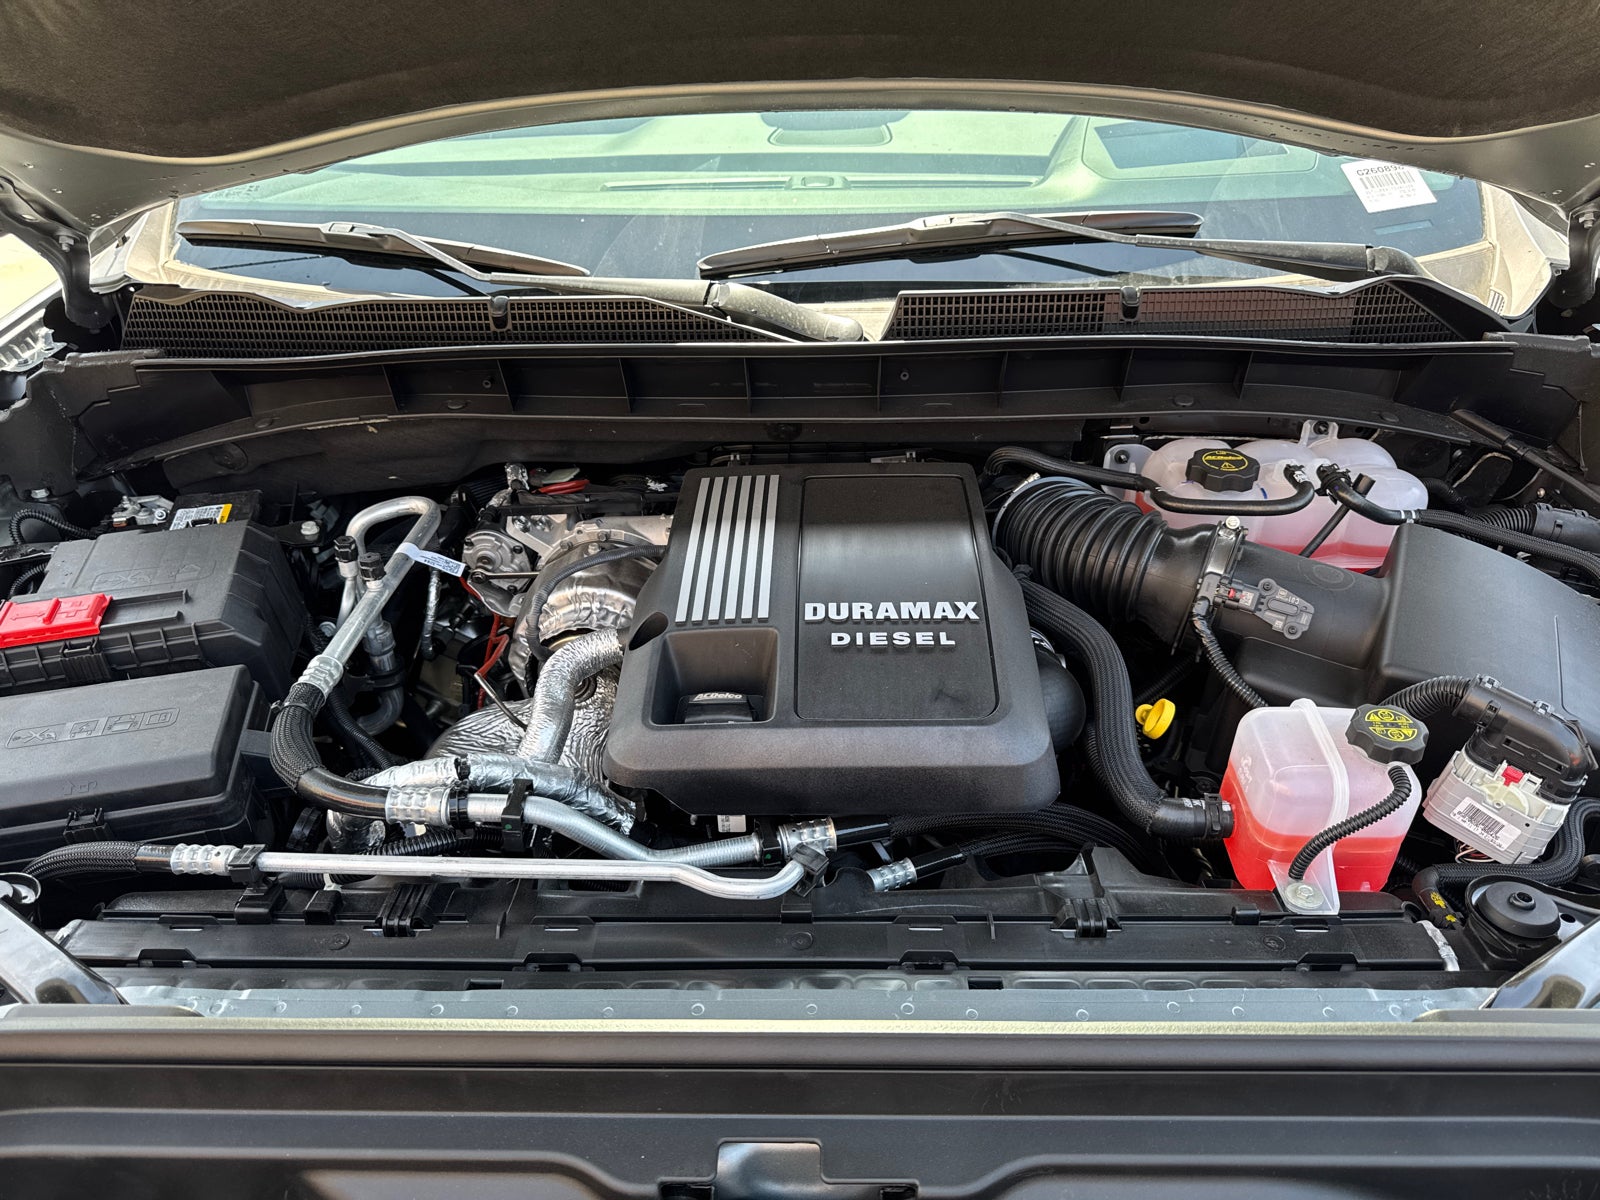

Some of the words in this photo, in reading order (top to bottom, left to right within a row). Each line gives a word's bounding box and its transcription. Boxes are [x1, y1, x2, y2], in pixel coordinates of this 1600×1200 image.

[804, 601, 980, 622] DURAMAX
[831, 631, 956, 646] DIESEL
[693, 692, 743, 701] ACDelco
